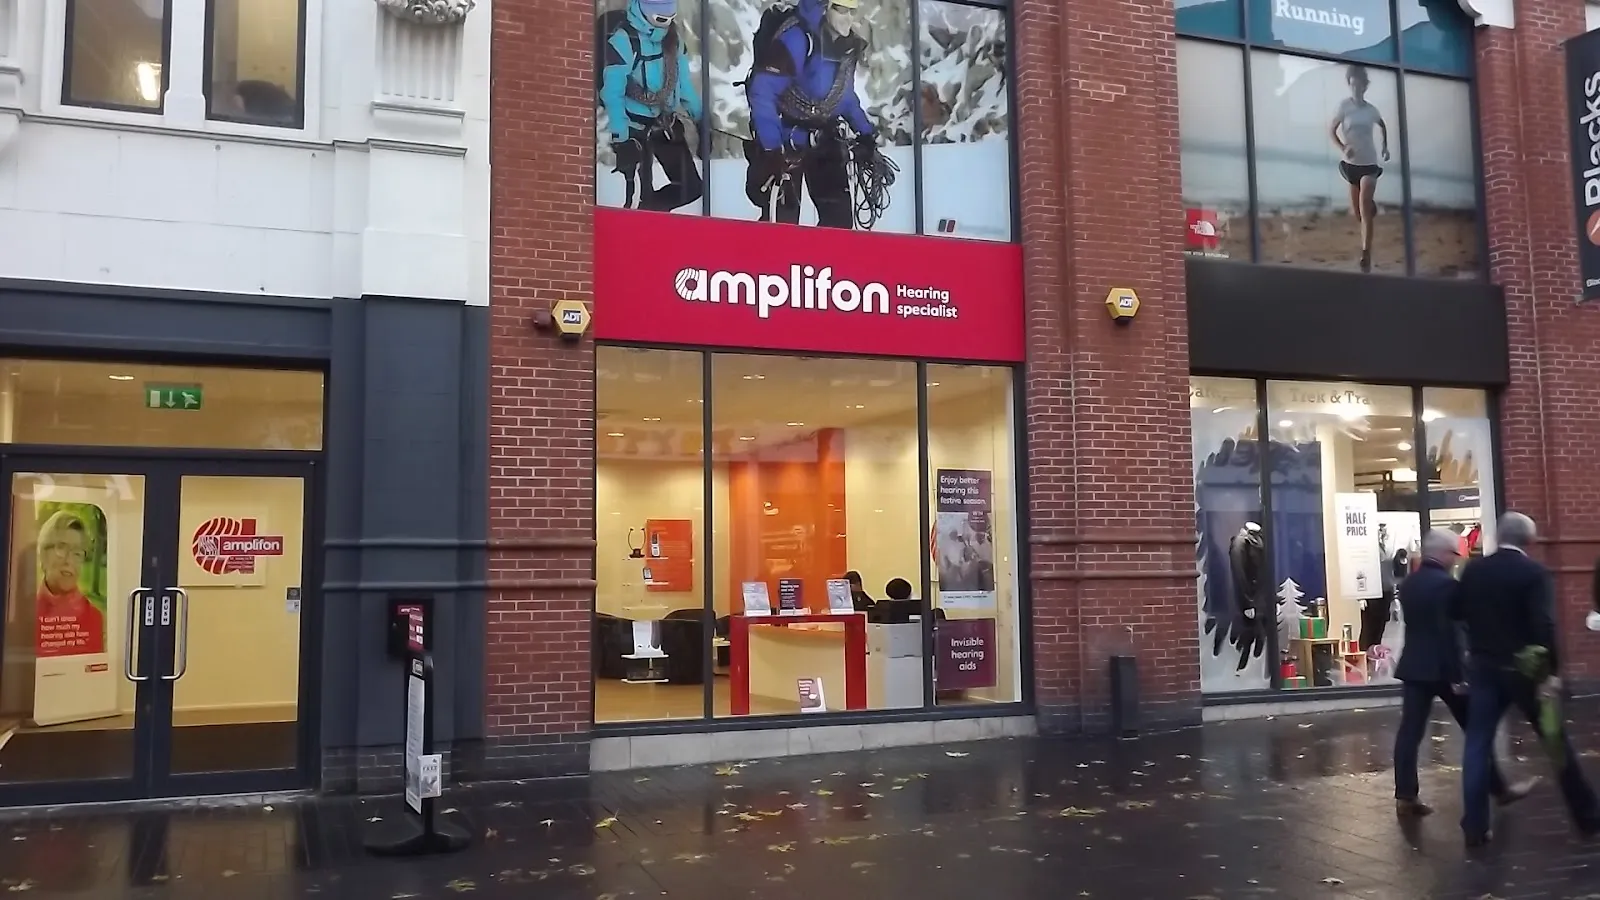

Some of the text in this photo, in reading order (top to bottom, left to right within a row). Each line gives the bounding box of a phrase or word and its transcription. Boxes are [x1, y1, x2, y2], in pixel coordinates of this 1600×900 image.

[1275, 0, 1364, 35] Running
[675, 264, 890, 318] amplifon
[896, 284, 950, 303] Hearing
[896, 303, 958, 319] specialist
[563, 312, 581, 322] ADT
[940, 475, 980, 485] Enjoy better
[940, 485, 979, 496] hearing this
[1345, 512, 1367, 524] HALF
[1346, 526, 1368, 536] PRICE
[223, 539, 280, 553] amplifon
[951, 637, 984, 647] Invisible
[951, 649, 985, 660] hearing
[959, 661, 977, 671] aids
